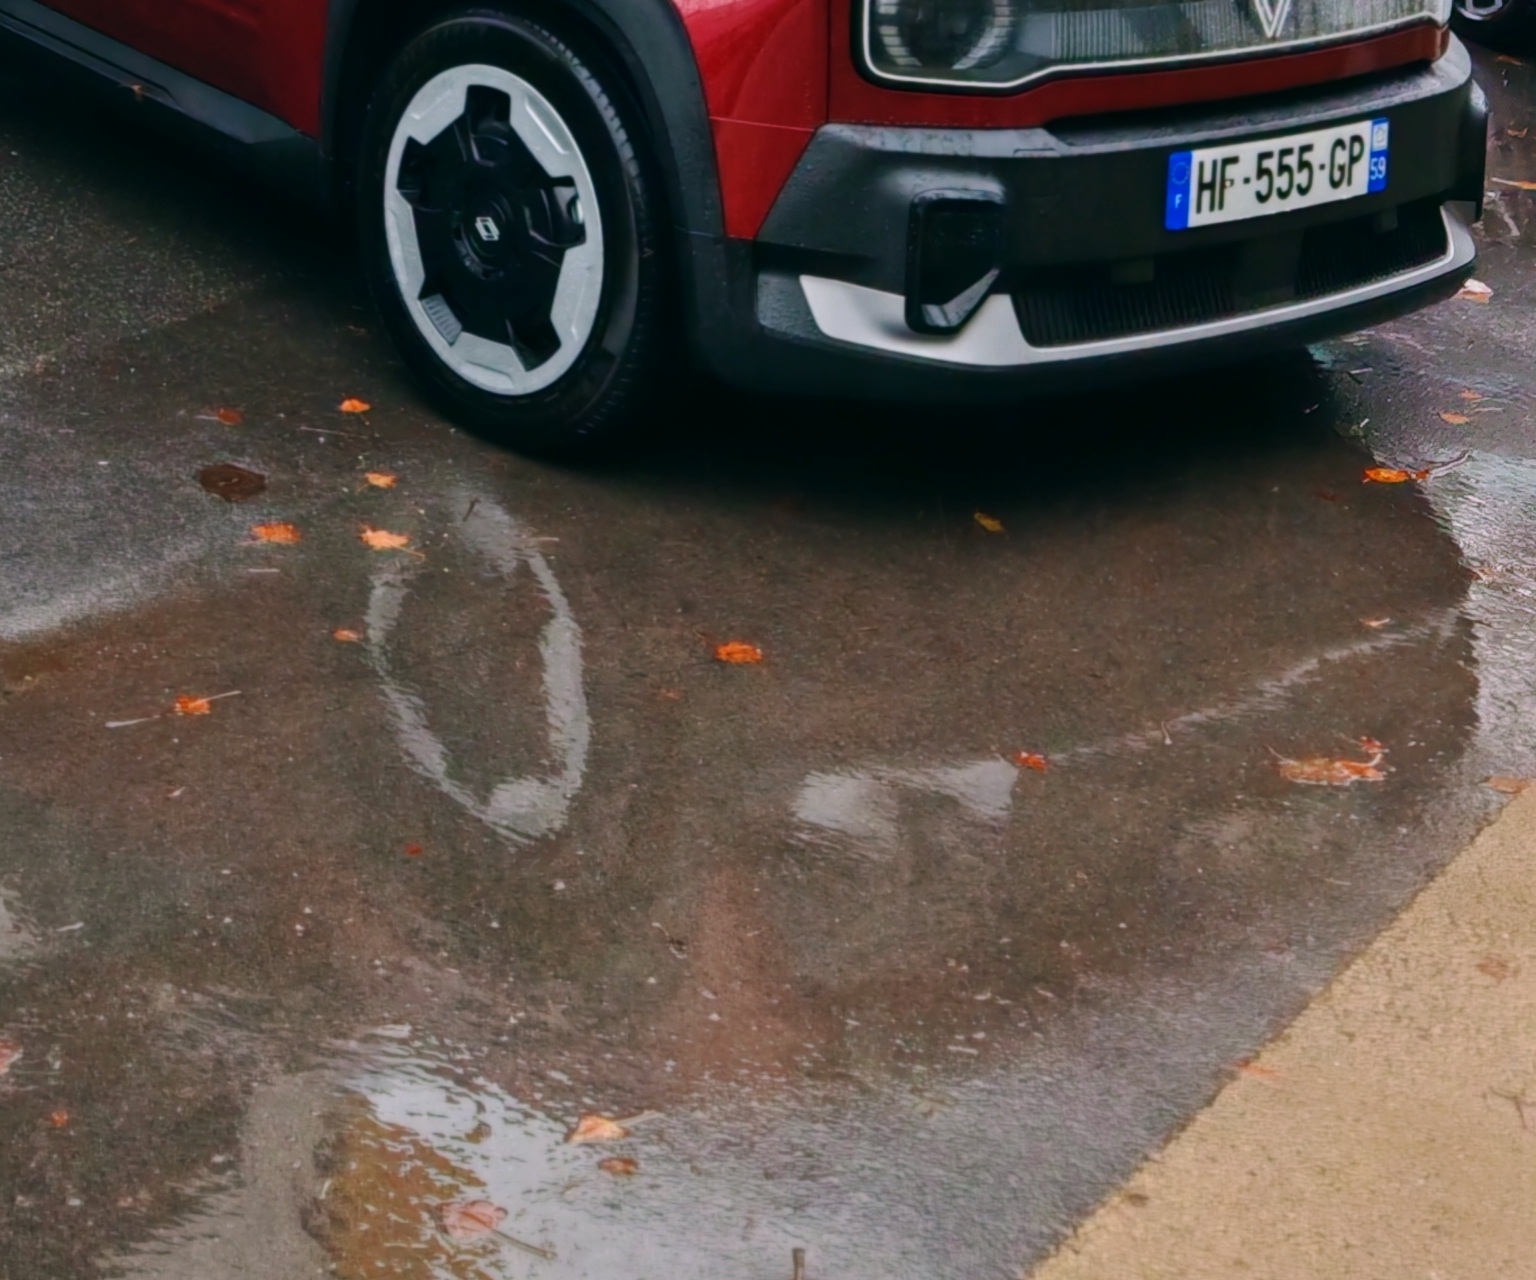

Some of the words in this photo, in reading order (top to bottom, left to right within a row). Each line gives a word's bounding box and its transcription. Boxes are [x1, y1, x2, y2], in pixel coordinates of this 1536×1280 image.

[1174, 193, 1183, 209] F
[1196, 134, 1366, 215] HF-555-GP
[1369, 156, 1387, 181] 59
